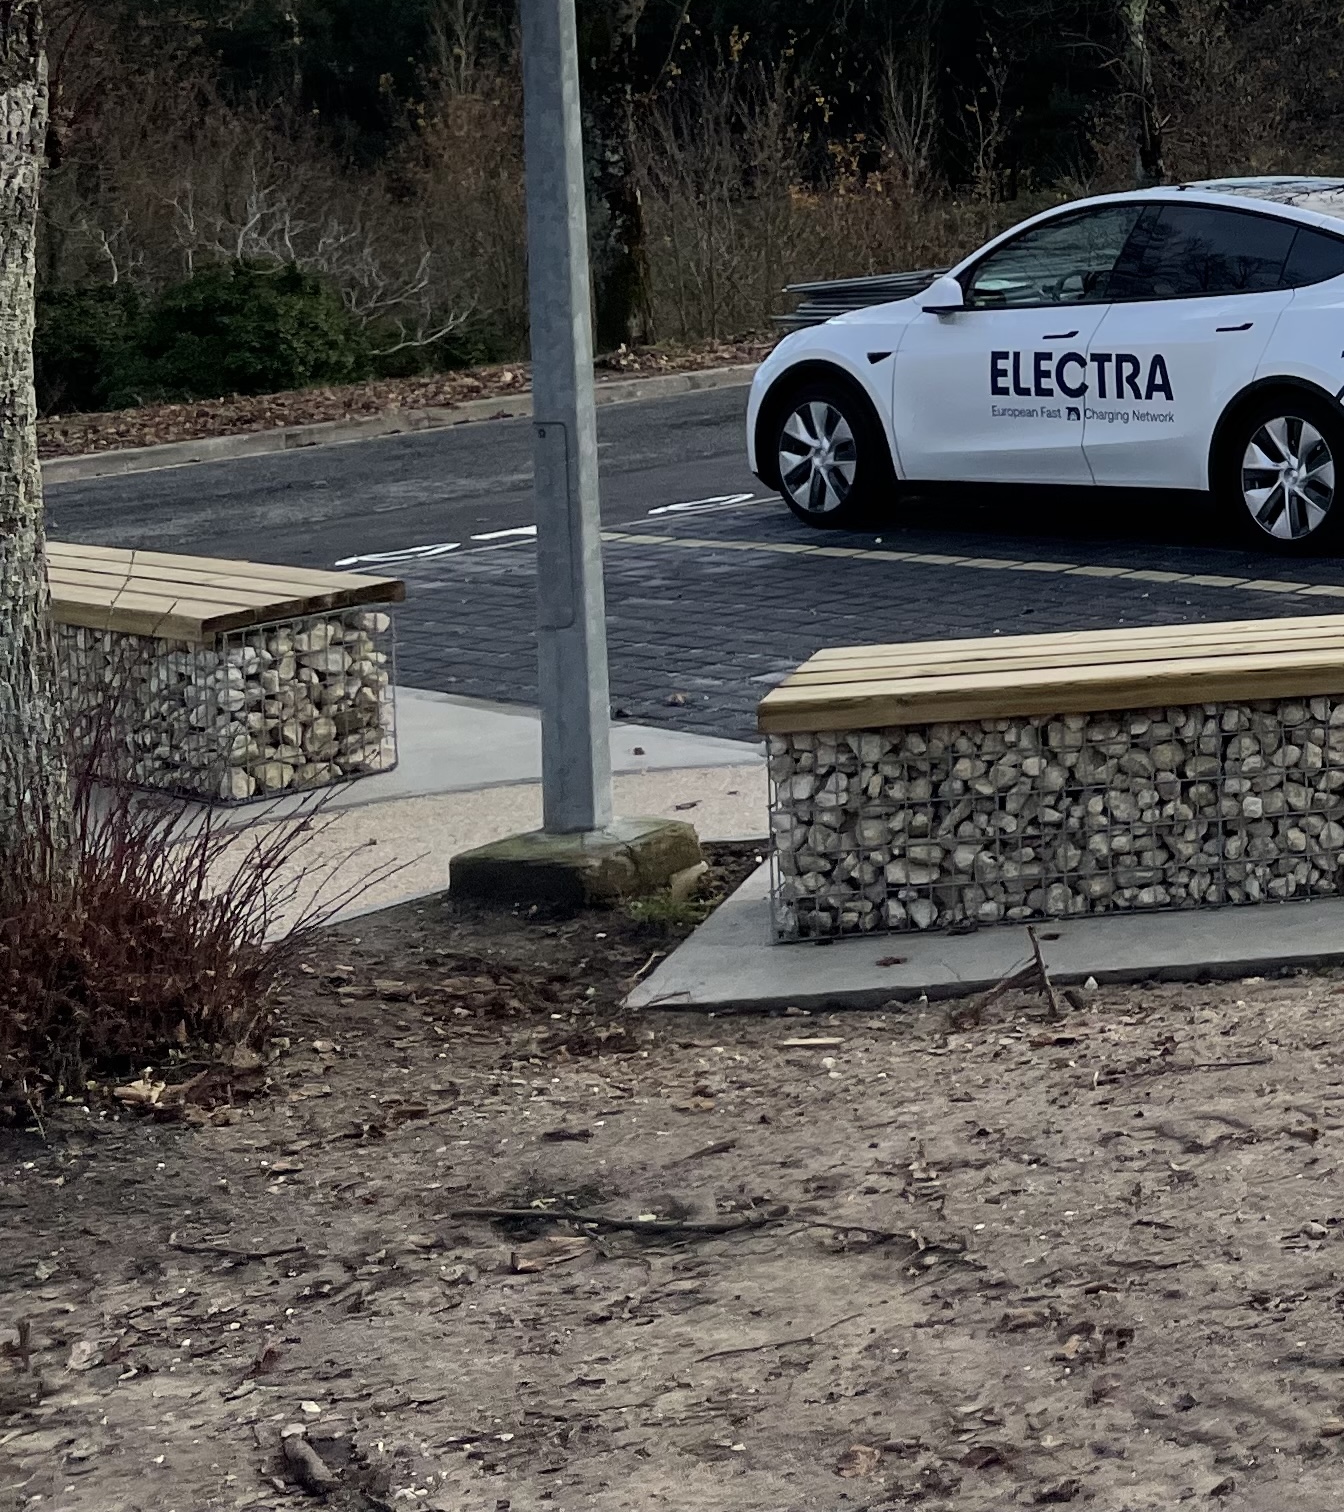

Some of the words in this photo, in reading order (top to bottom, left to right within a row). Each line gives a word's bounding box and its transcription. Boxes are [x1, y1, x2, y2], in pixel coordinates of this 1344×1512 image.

[991, 351, 1174, 401] ELECTRA
[992, 405, 1039, 419] European
[1041, 406, 1062, 419] Fast
[1085, 408, 1129, 424] Charging
[1132, 410, 1175, 423] Network
